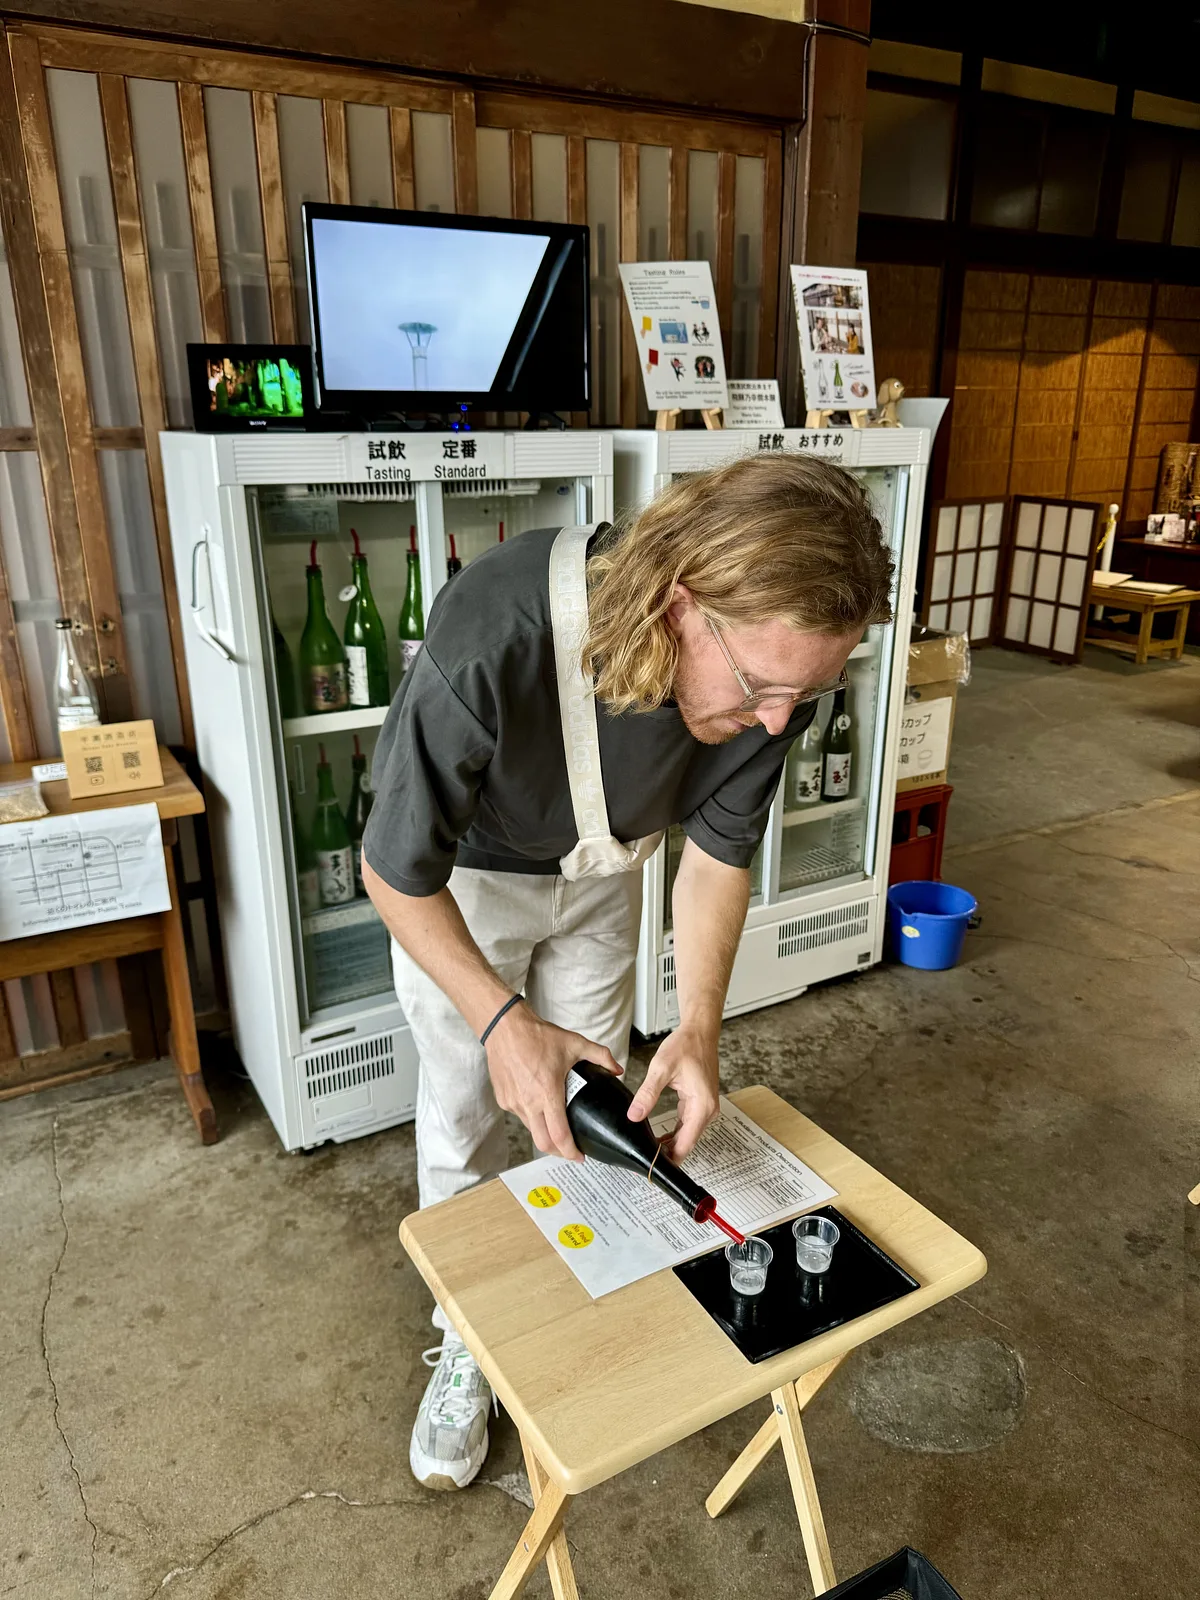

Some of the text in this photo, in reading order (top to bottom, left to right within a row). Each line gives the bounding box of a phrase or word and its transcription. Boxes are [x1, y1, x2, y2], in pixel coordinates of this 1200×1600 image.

[368, 439, 477, 460] 試飲 定番
[759, 433, 844, 450] 試飲 おすすめ
[365, 464, 486, 480] Tasting Standard
[568, 694, 593, 773] adidas
[754, 1135, 778, 1153] Products
[774, 1151, 805, 1175] Description
[530, 1187, 550, 1207] your stay
[562, 1228, 581, 1246] allowed
[570, 1223, 591, 1243] No food
